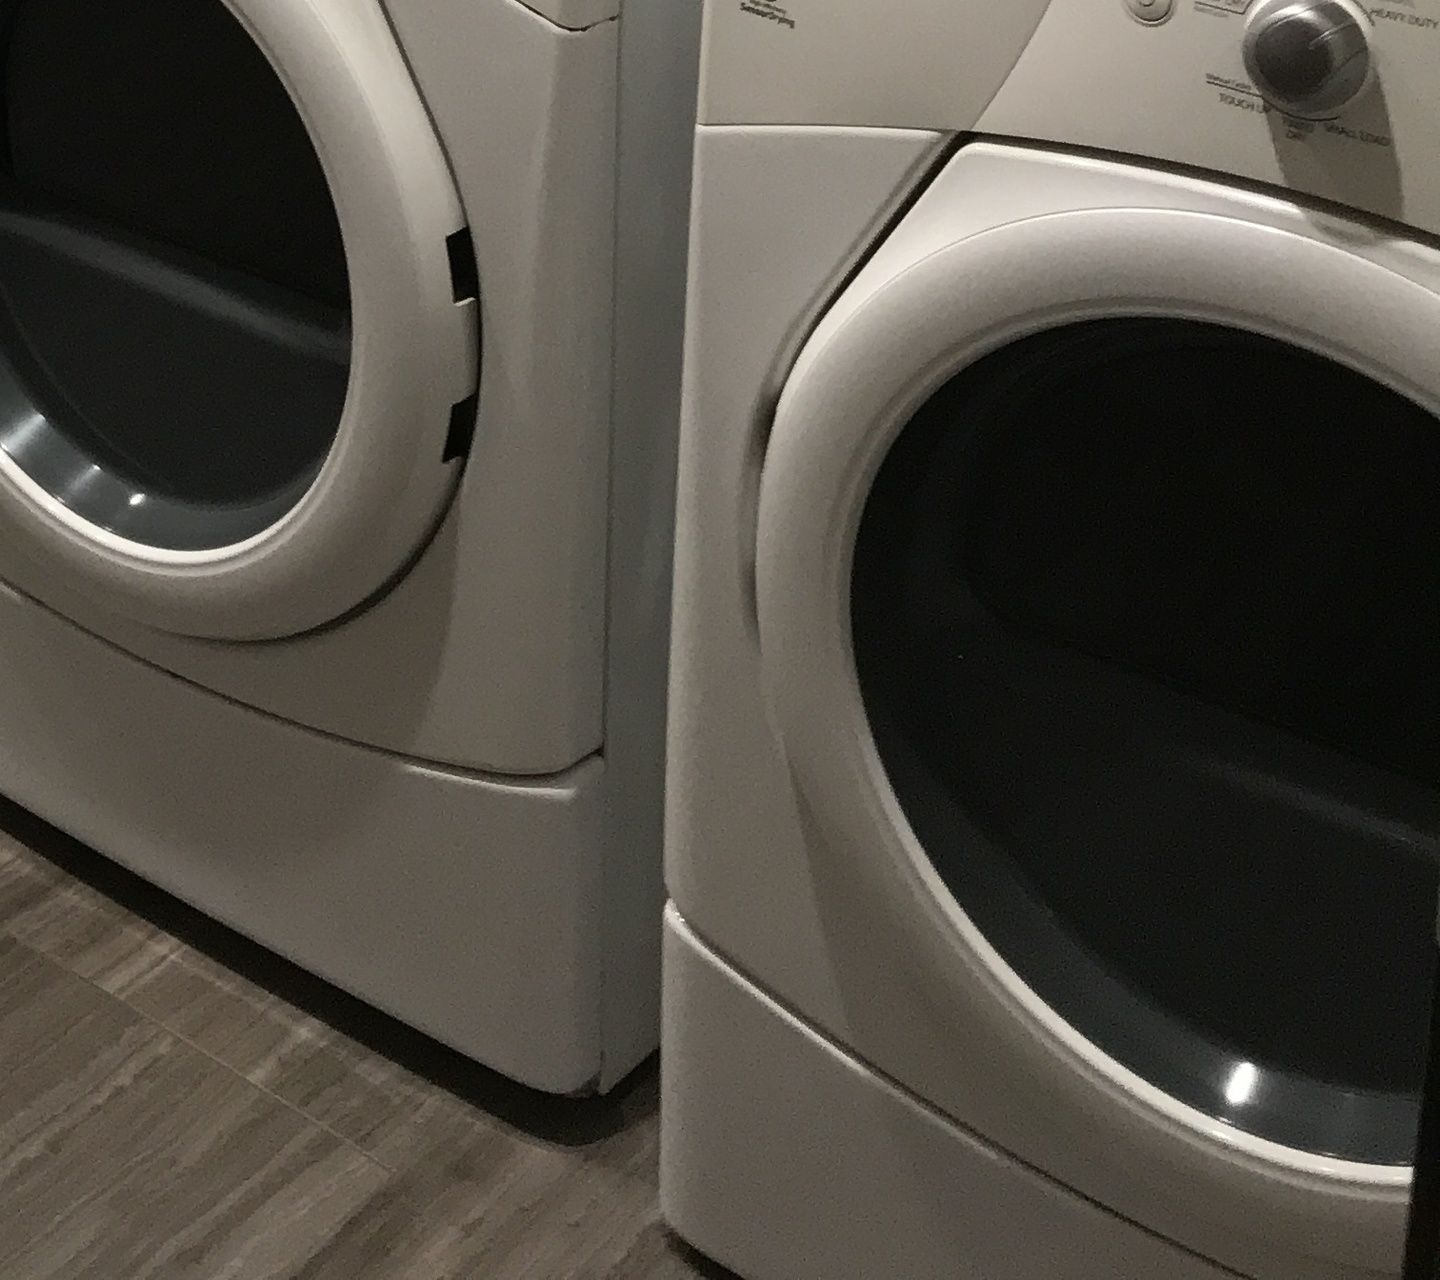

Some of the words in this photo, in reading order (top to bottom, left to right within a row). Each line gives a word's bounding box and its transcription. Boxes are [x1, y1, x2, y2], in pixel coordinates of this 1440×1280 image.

[1370, 8, 1406, 24] HEAVY
[1408, 15, 1440, 31] DUTY
[1218, 93, 1255, 112] TOUCH
